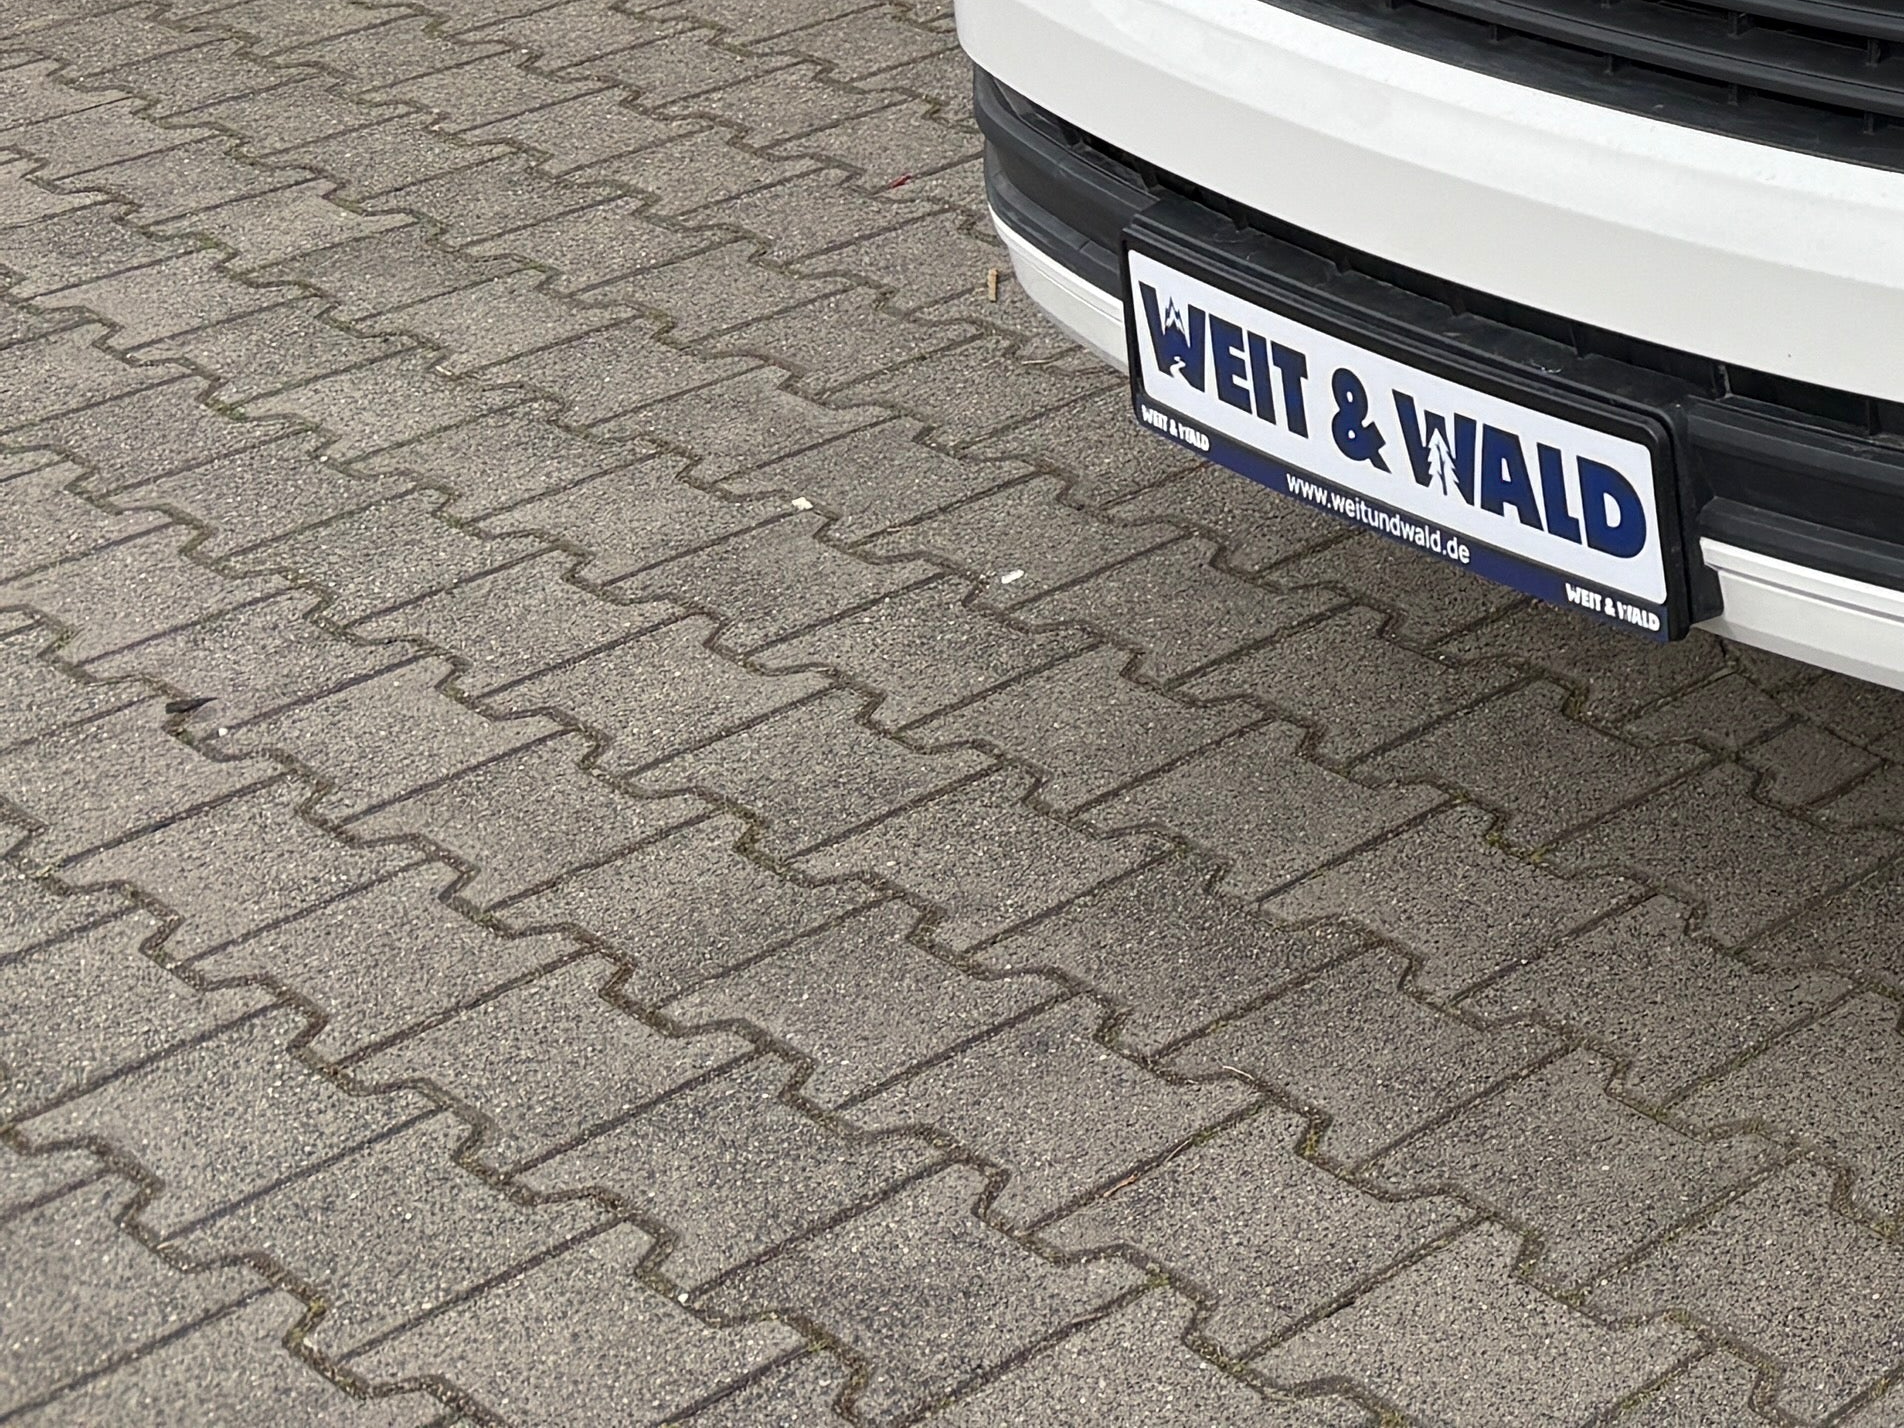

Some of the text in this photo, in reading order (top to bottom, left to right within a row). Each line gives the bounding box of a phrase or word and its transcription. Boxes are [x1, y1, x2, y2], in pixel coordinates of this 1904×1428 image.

[1139, 281, 1647, 559] WEIT & WALD
[1287, 473, 1471, 564] www.weitundwald.de
[1565, 582, 1661, 632] WEIT & WALD
